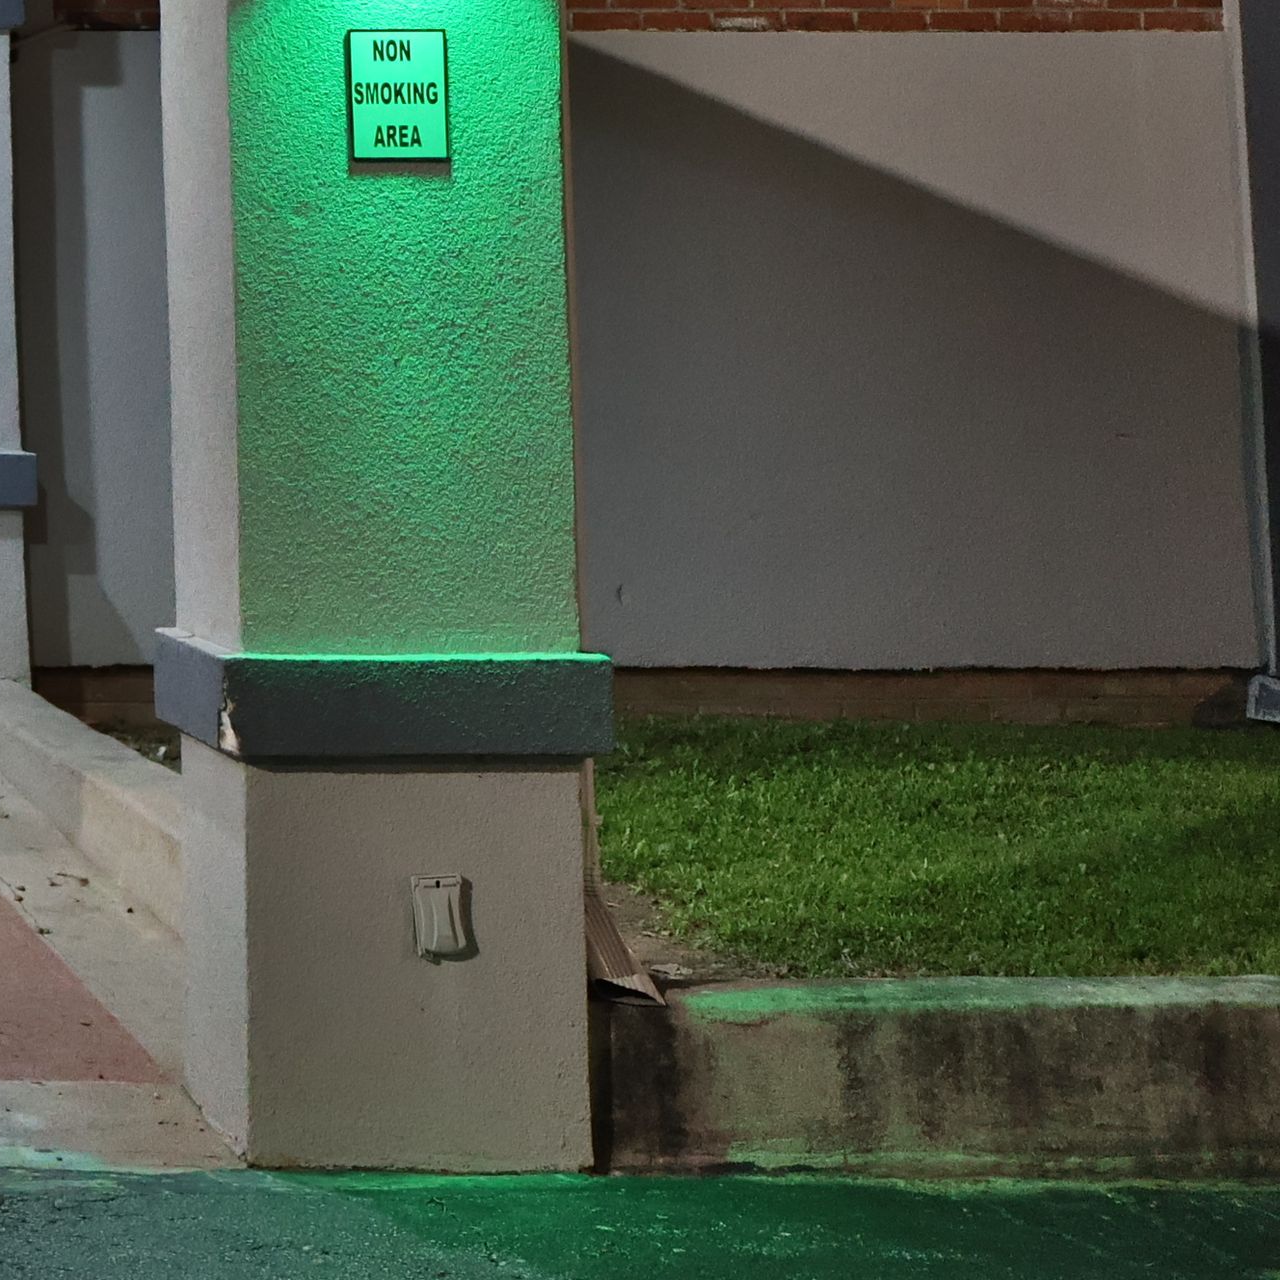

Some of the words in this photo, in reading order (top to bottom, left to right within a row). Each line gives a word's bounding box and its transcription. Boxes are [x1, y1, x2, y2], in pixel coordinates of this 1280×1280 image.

[373, 39, 411, 62] NON
[354, 81, 438, 105] SMOKING
[374, 125, 422, 148] AREA
